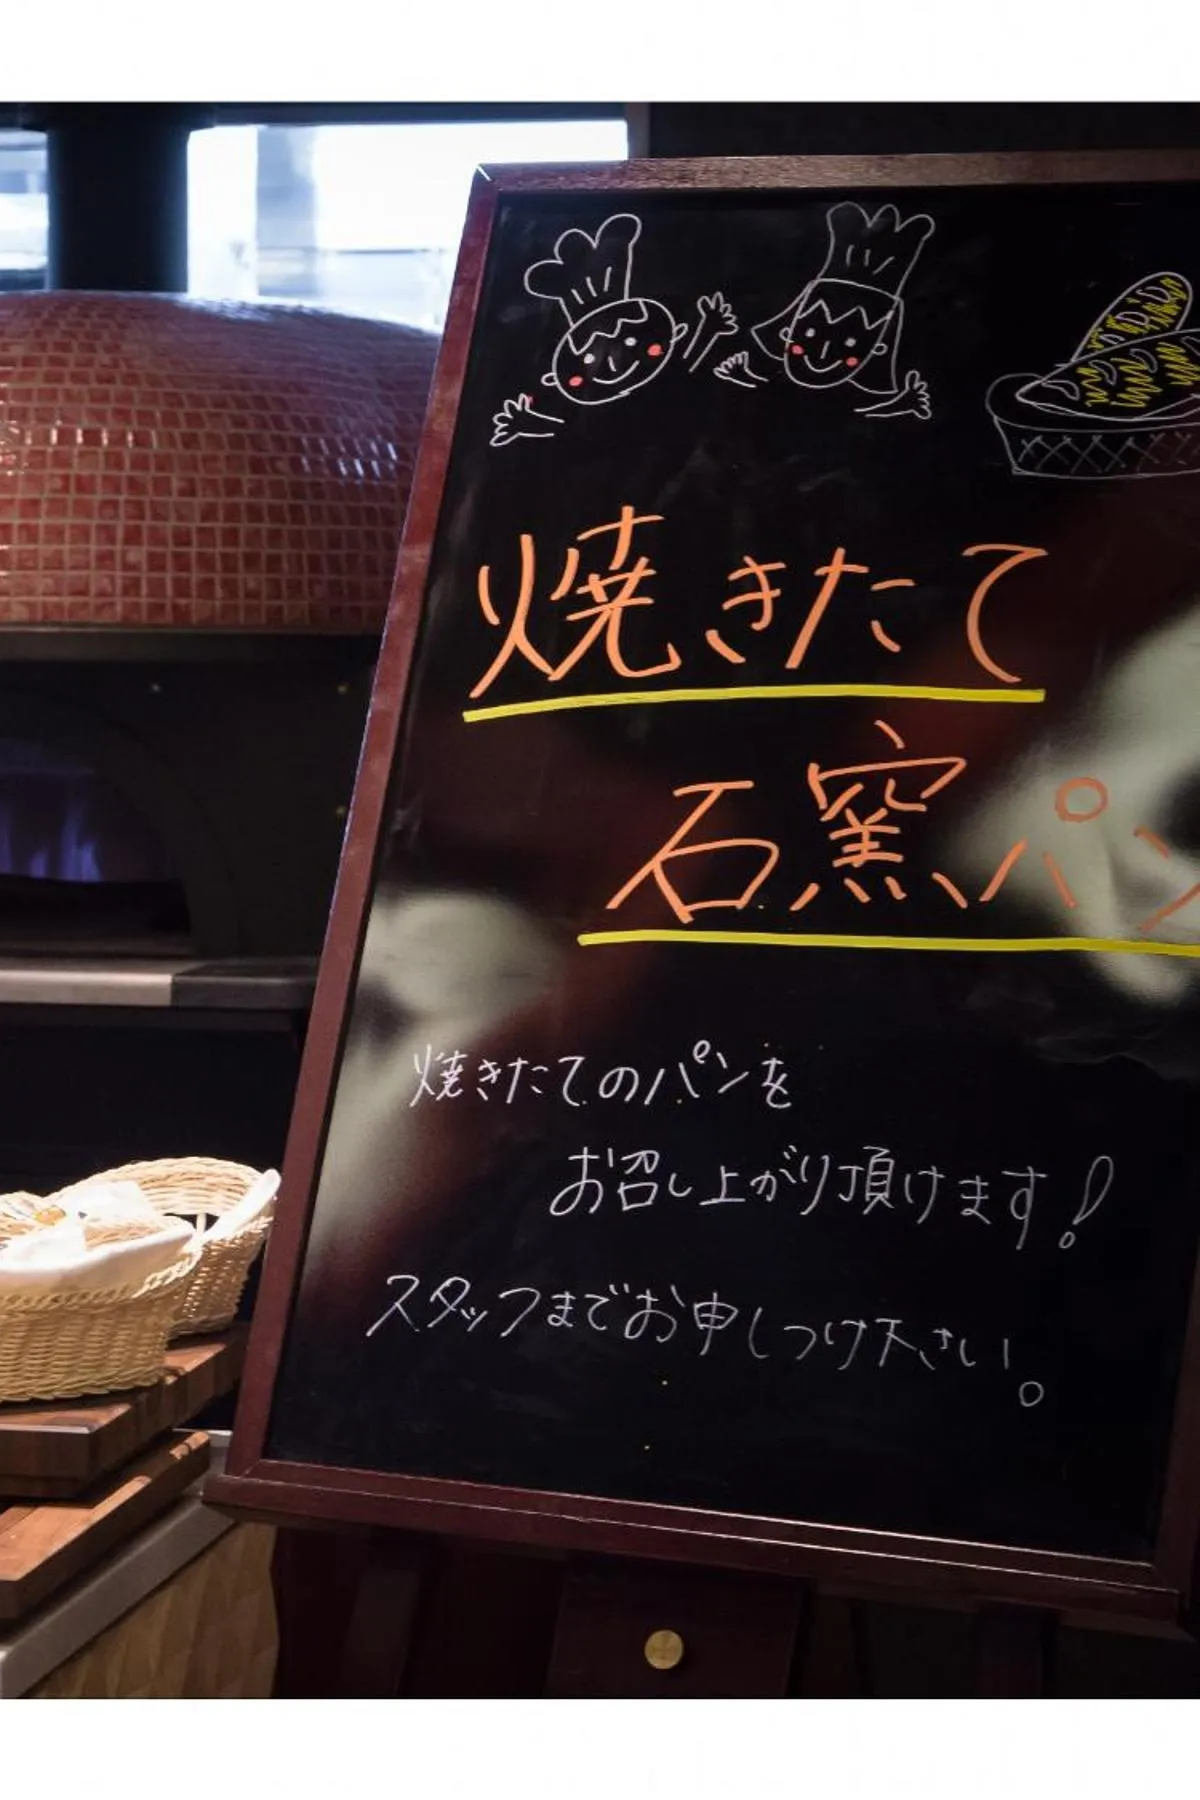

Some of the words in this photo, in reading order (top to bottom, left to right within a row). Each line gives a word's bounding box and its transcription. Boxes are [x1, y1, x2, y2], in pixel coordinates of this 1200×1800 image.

[470, 506, 1048, 698] 焼きたて
[410, 1039, 792, 1108] 焼きたてのパンを
